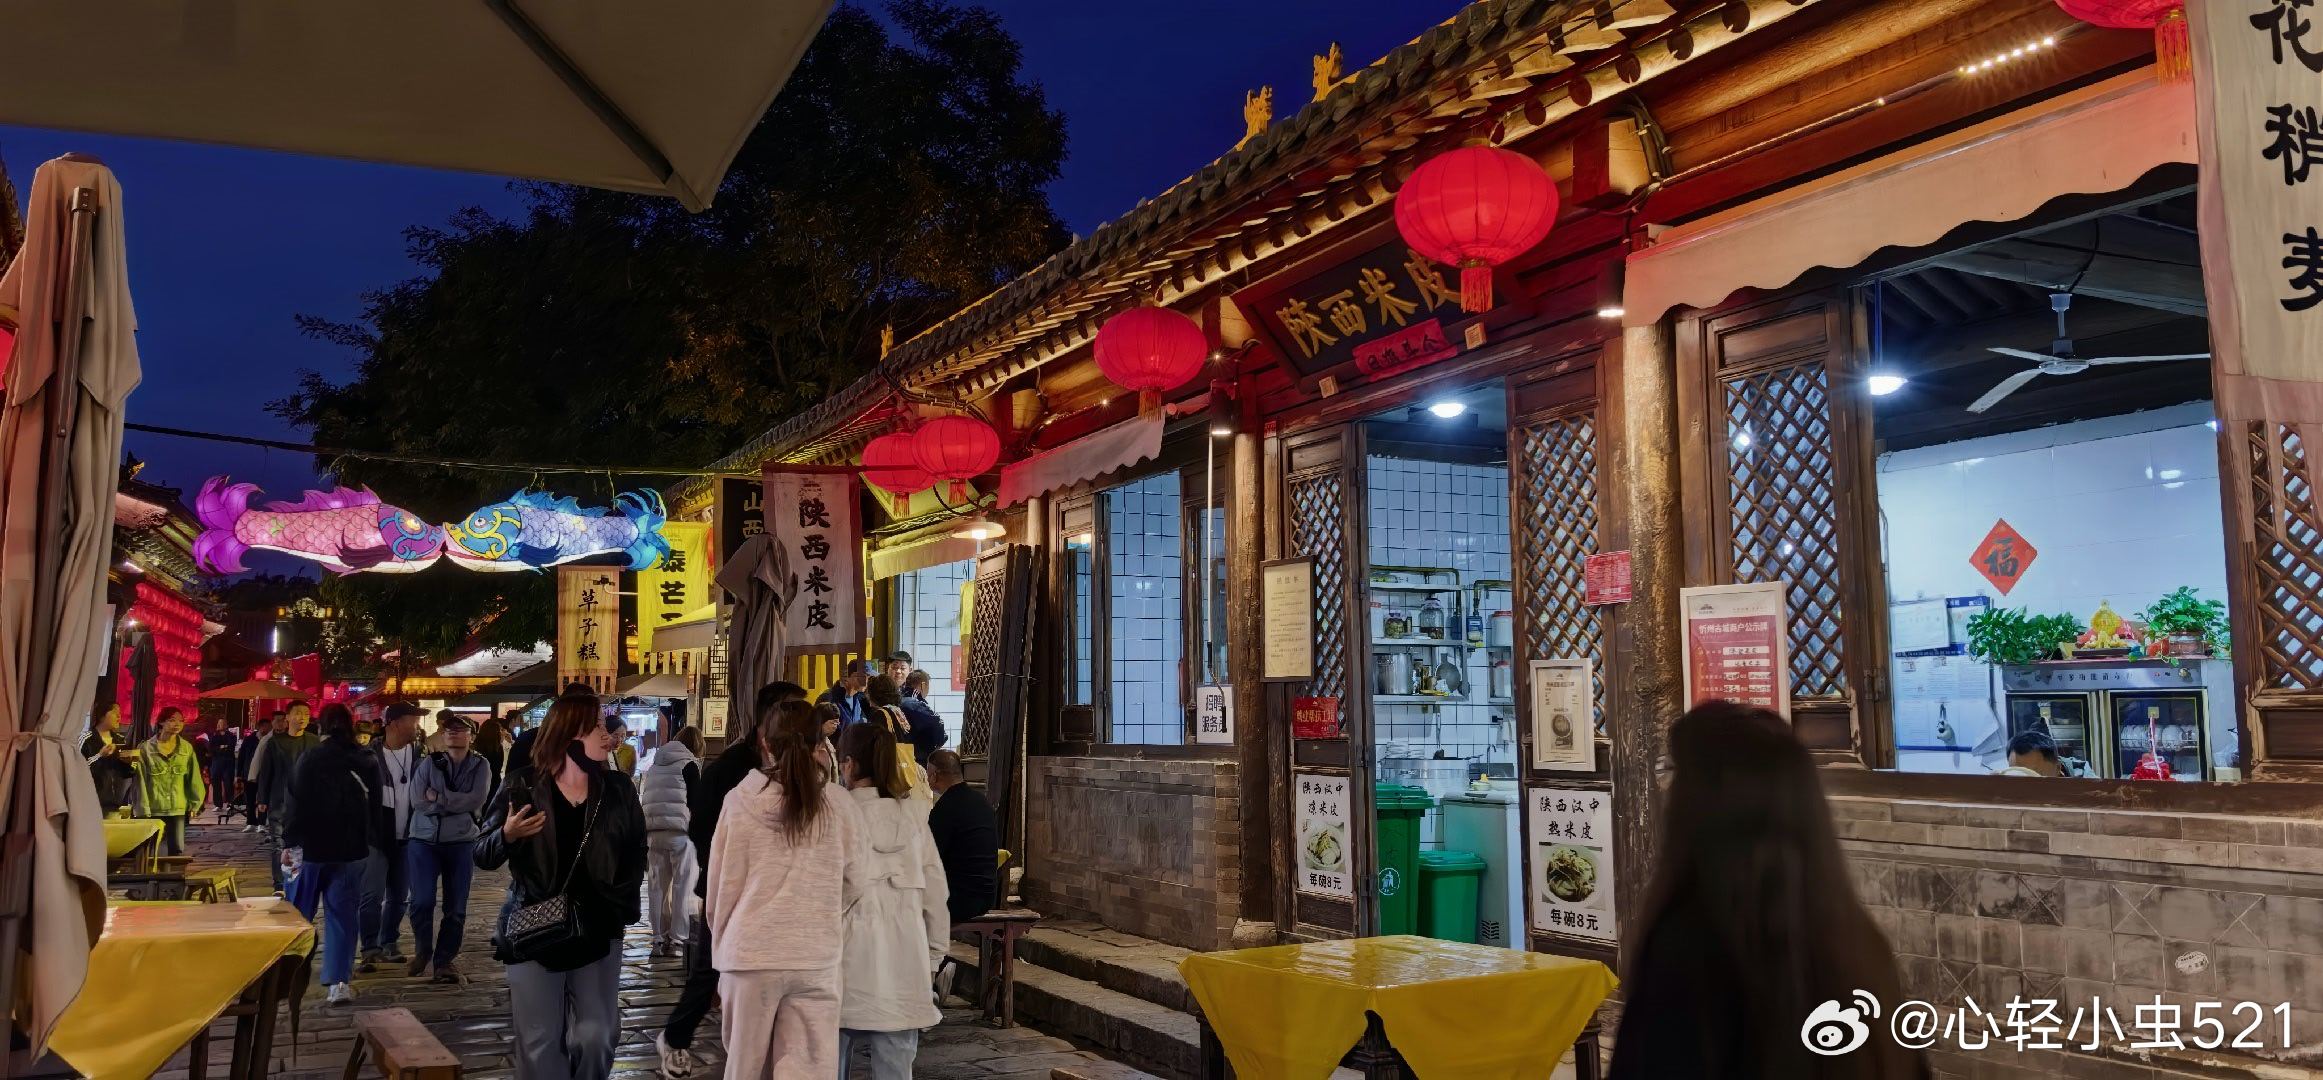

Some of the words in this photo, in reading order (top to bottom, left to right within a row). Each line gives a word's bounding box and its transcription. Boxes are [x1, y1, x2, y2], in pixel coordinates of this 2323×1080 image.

[1276, 249, 1461, 359] 陕西米皮
[799, 497, 835, 630] 陕西米皮
[1984, 537, 2019, 577] 福
[577, 589, 600, 661] 草子糕
[1302, 781, 1344, 796] 陕西汉中
[1540, 796, 1600, 814] 陕西汉中
[1548, 820, 1594, 840] 热米皮
[1309, 872, 1342, 890] 每碗8元
[1550, 908, 1599, 931] 每碗8元
